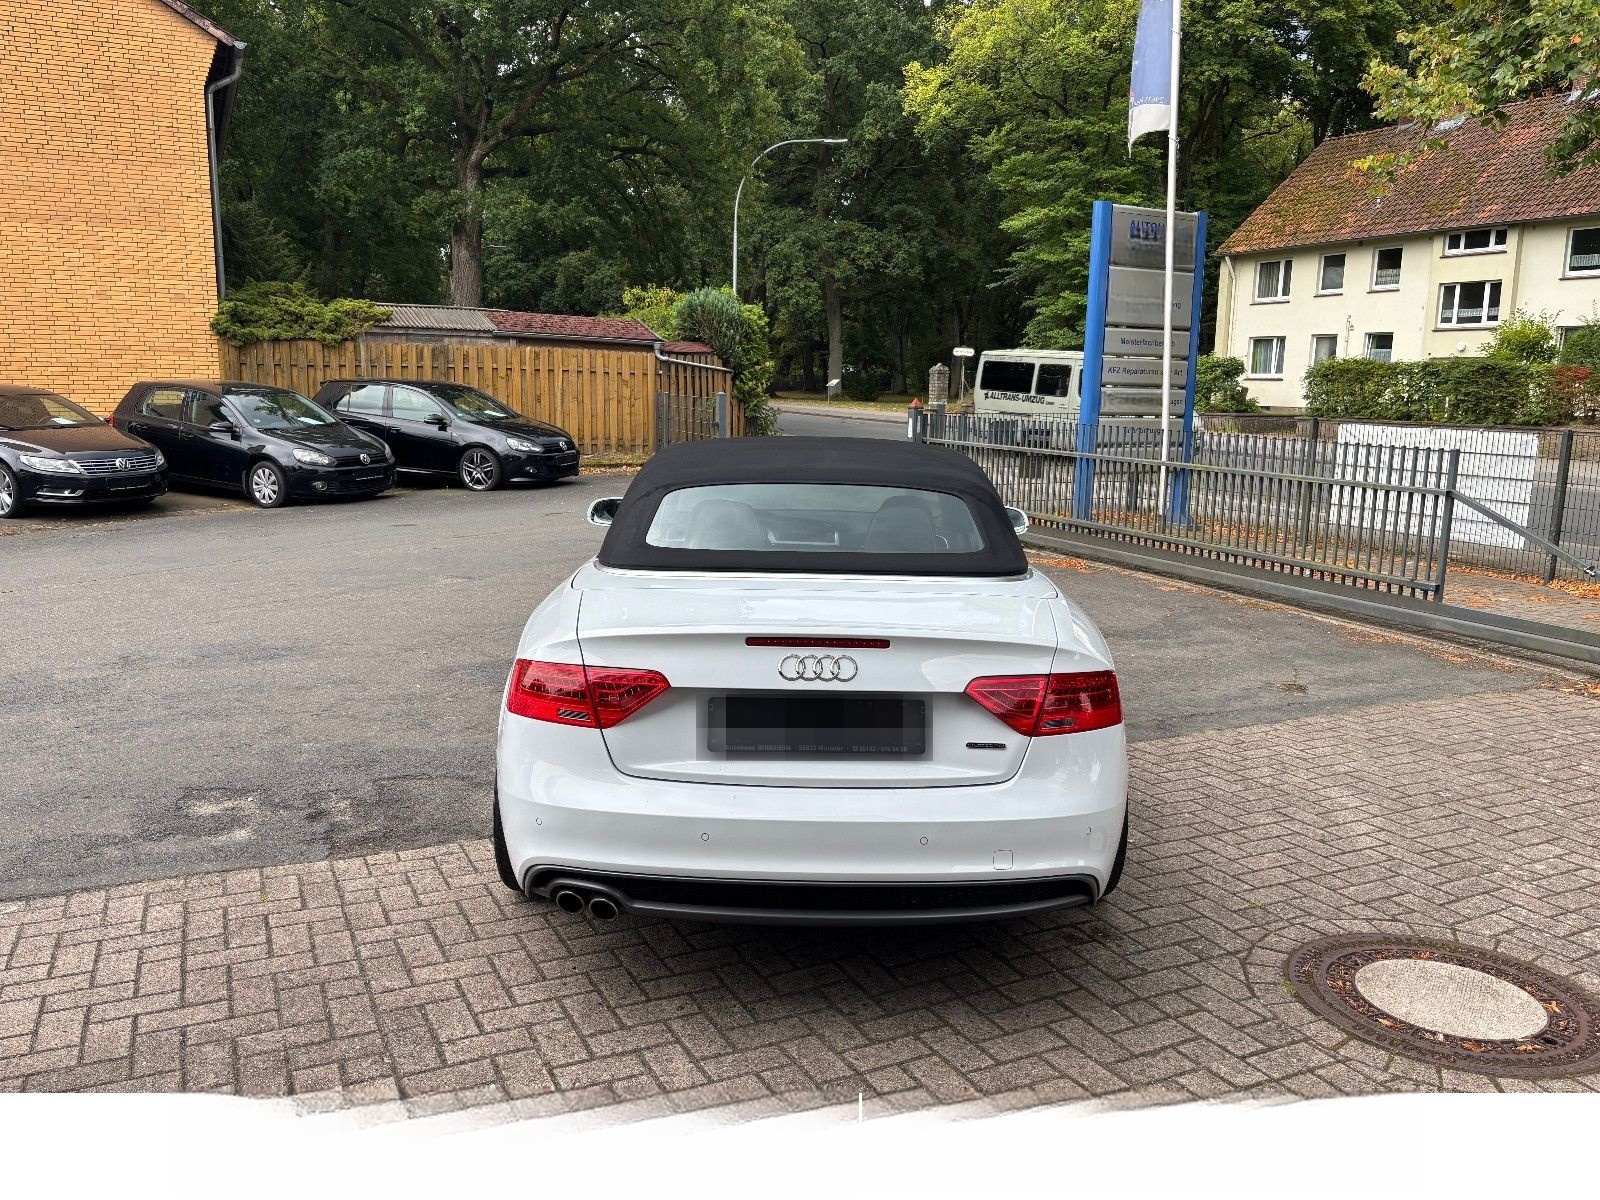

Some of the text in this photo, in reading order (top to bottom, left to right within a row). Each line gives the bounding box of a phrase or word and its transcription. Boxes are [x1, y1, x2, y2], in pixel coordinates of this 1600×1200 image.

[1107, 366, 1121, 374] KFZ
[1121, 367, 1158, 376] Reparaturen
[1173, 368, 1183, 376] Art
